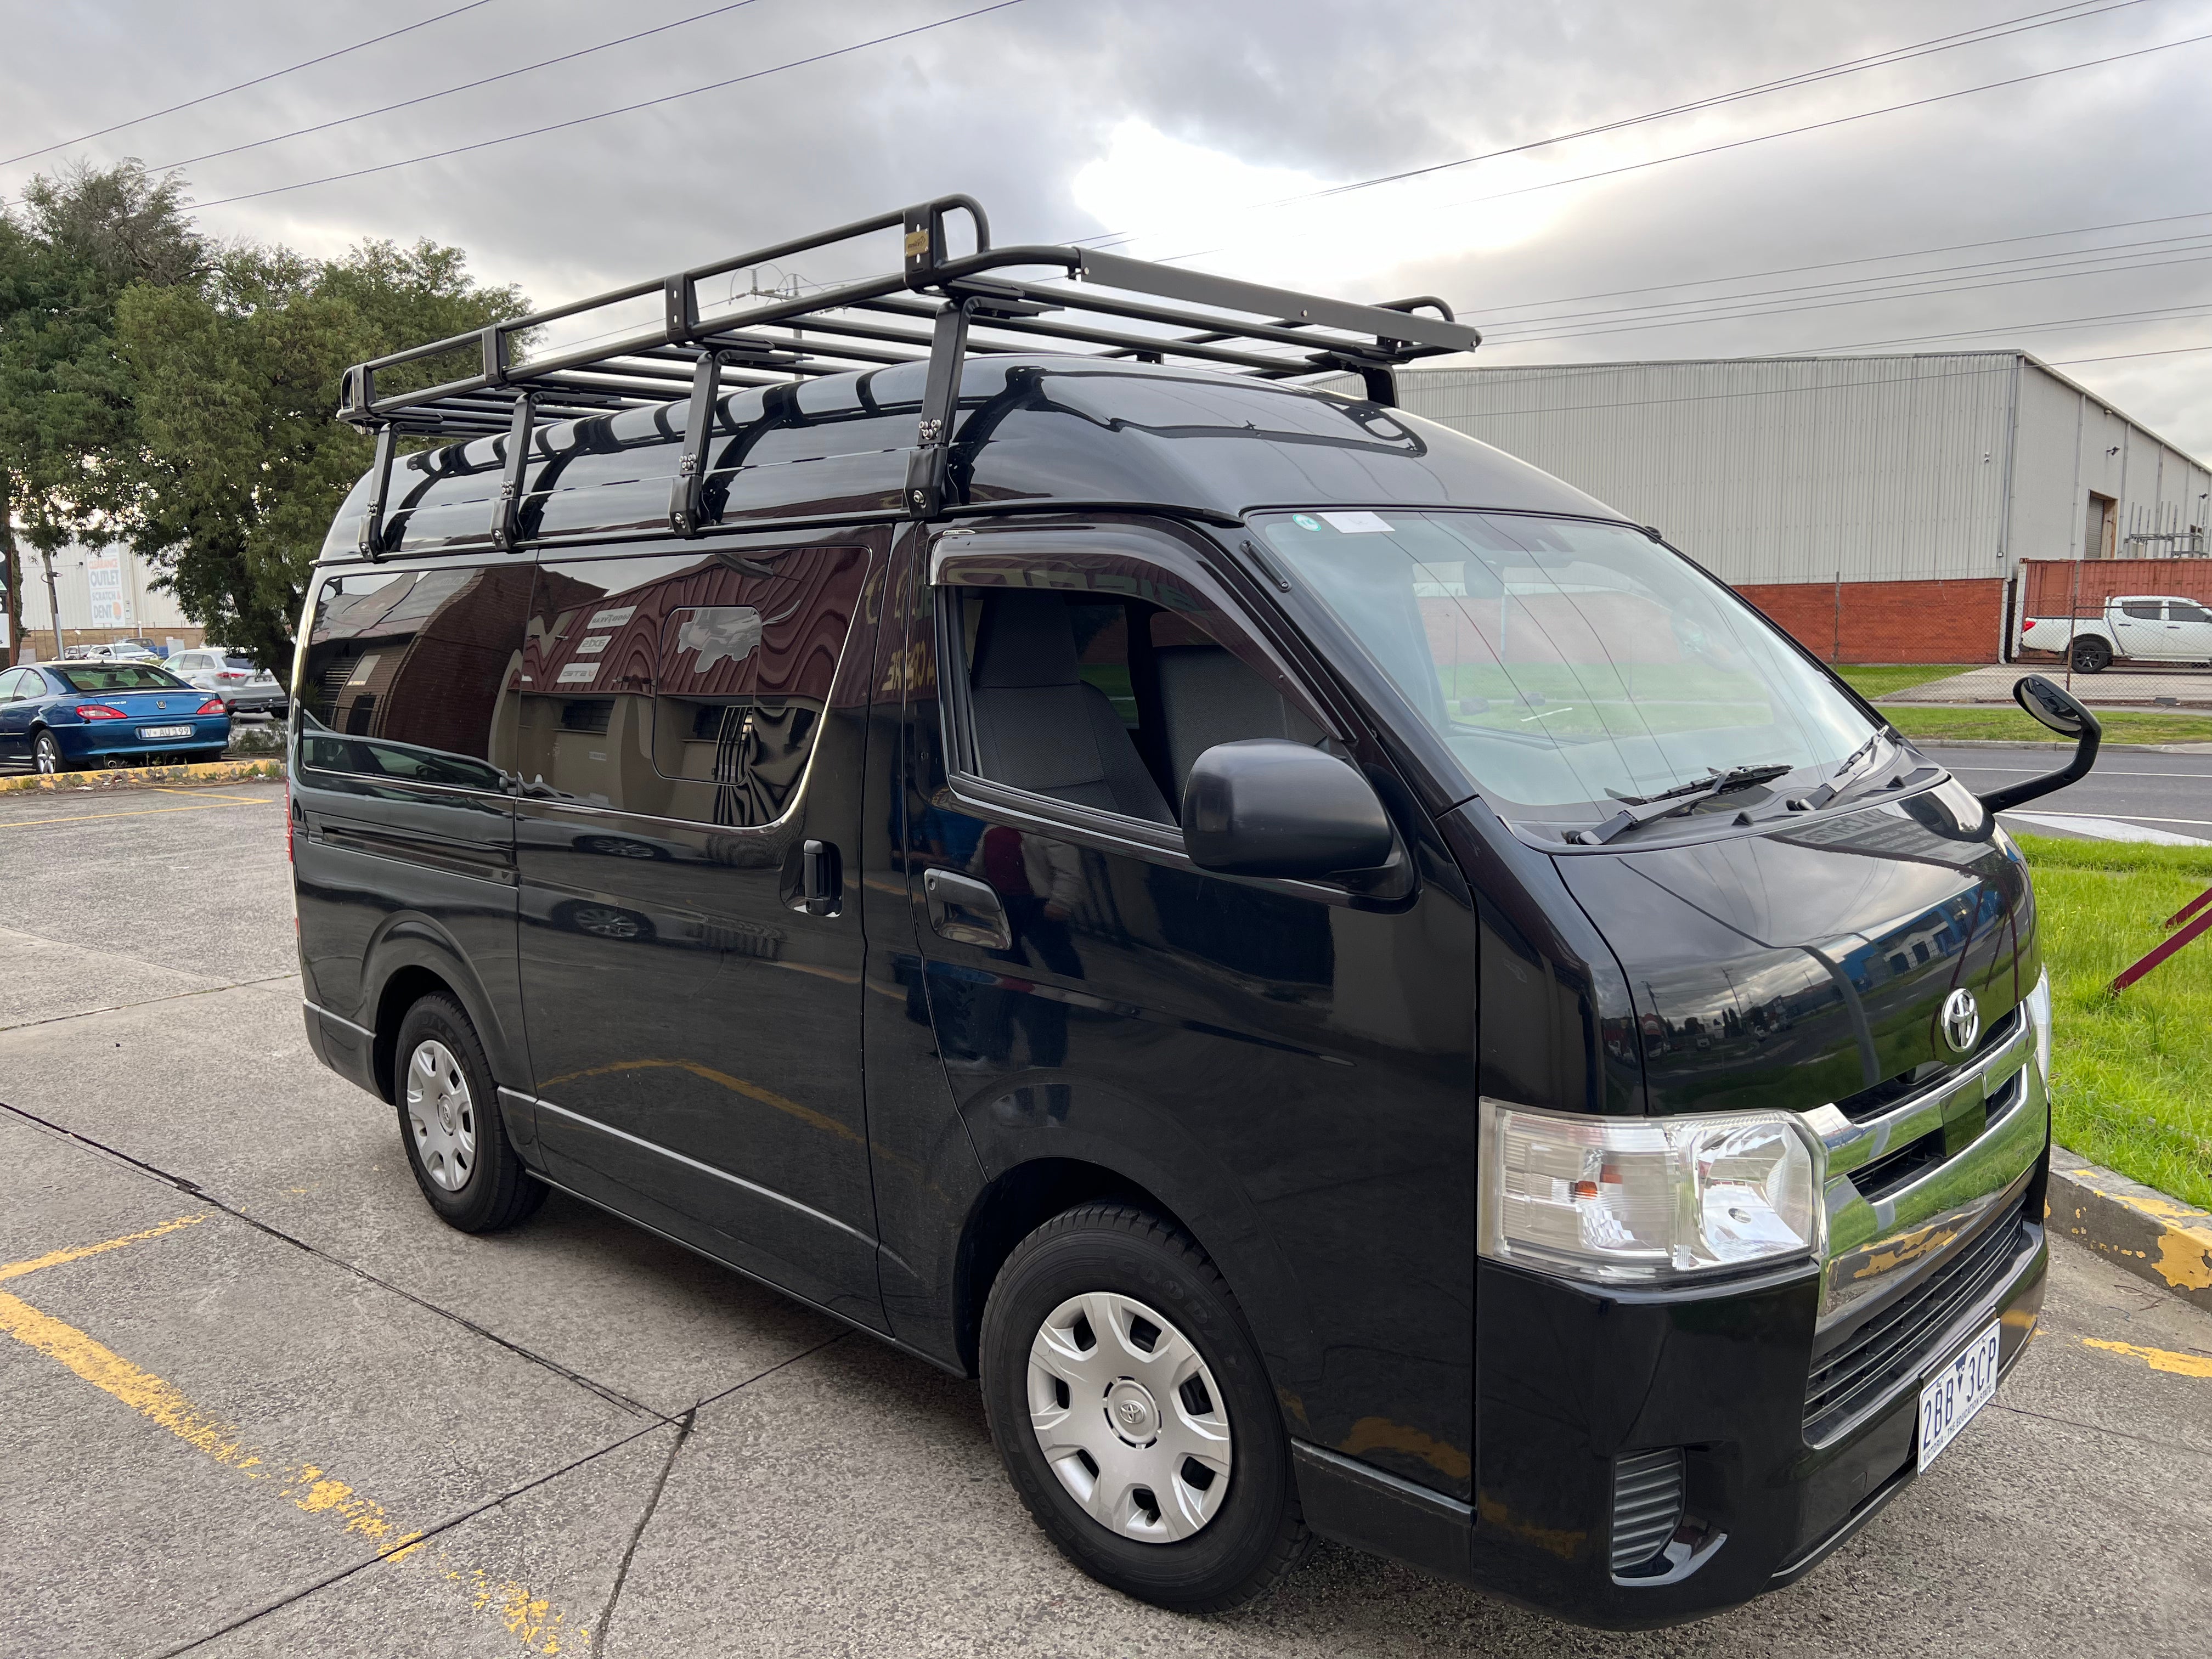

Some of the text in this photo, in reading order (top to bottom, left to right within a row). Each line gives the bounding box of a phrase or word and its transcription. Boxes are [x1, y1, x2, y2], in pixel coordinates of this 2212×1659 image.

[89, 558, 118, 569] CLEARANCE
[90, 569, 119, 586] OUTLET
[92, 591, 121, 601] SCRATCH &
[93, 604, 112, 619] DENT
[172, 727, 189, 736] 199
[1923, 1337, 1996, 1451] 2BB 3CP
[1923, 1383, 1992, 1463] VICTORIA THE EDUCATION STATE
